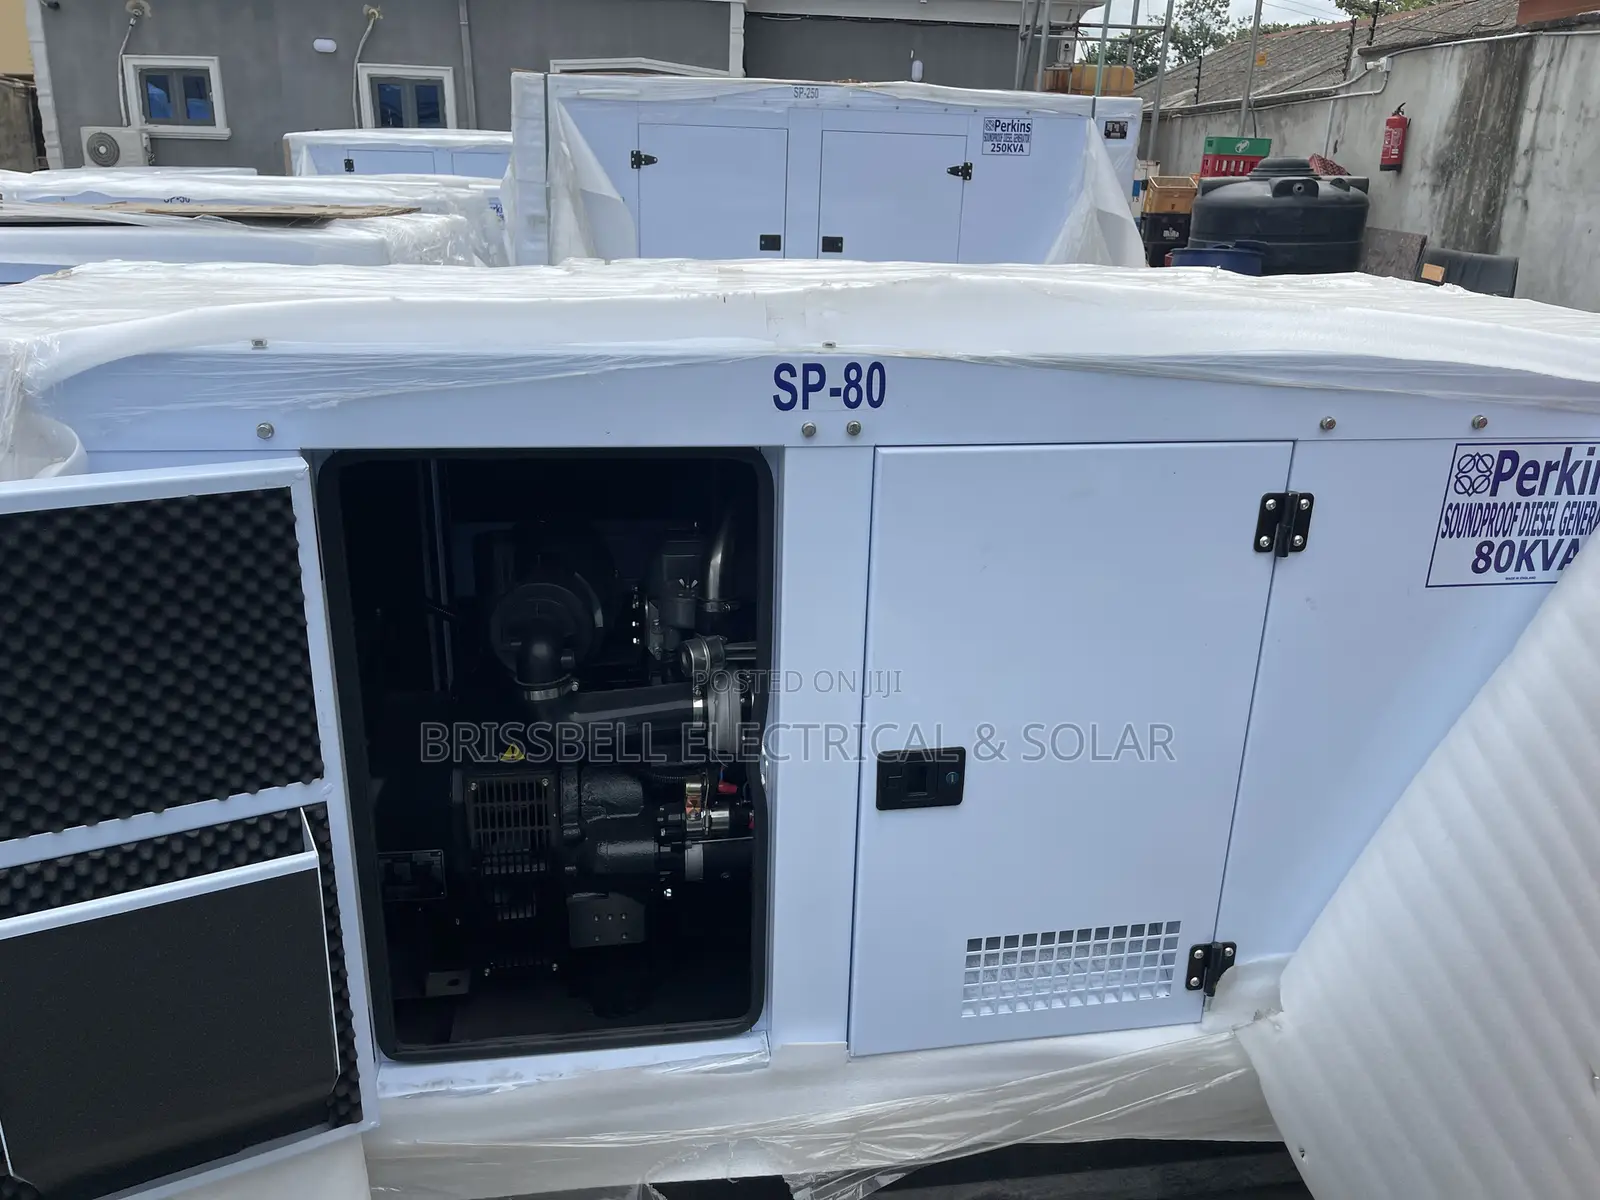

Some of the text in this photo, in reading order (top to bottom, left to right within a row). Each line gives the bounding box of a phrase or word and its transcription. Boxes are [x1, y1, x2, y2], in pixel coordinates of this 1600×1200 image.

[794, 87, 819, 98] SP-250
[995, 119, 1031, 132] Perkins
[990, 143, 1024, 153] 250KVA
[772, 361, 886, 411] SP-80
[1441, 501, 1522, 538] SOUNDPROOF
[1517, 501, 1559, 537] DIESEL
[1471, 538, 1580, 574] 80KVA
